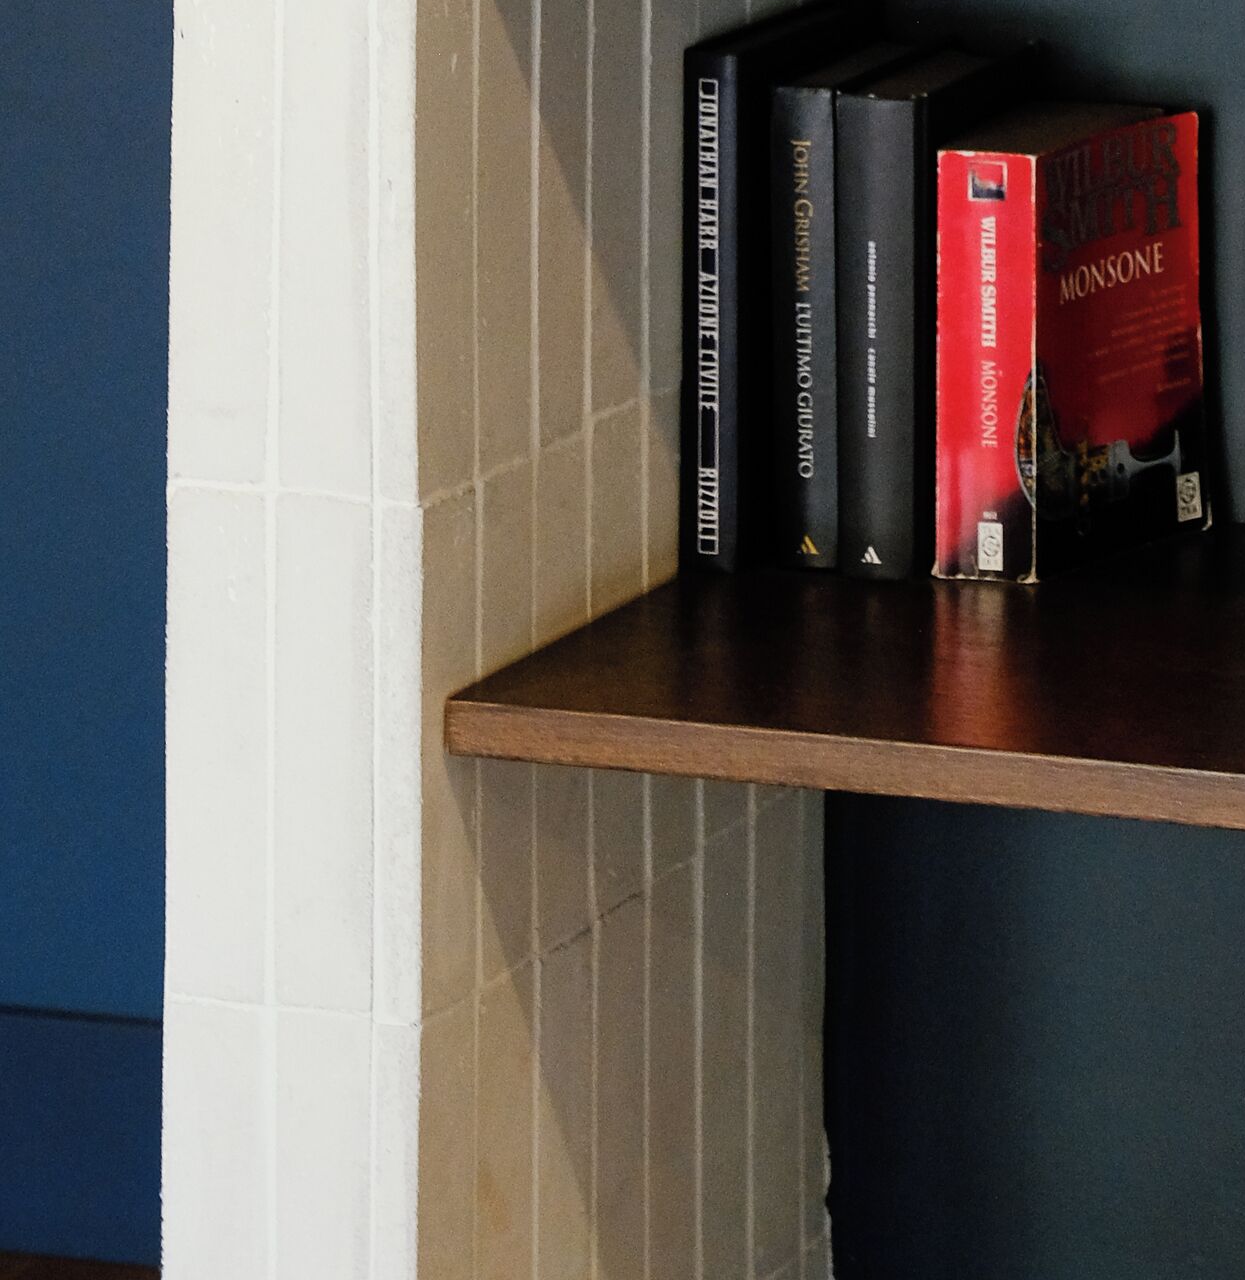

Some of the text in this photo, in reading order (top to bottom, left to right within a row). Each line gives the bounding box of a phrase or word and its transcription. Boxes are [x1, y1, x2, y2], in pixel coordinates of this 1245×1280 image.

[699, 93, 716, 410] JONATHAN HARR AZIONE CIVILE
[979, 215, 996, 347] WILBUR SMITH
[1058, 241, 1166, 305] MONSONE
[790, 139, 813, 478] JOHN GRISHAM L'ULTIMO GIURATO
[866, 385, 876, 438] mussolini
[979, 359, 997, 448] MONSONE
[698, 467, 717, 540] RIZZOLI
